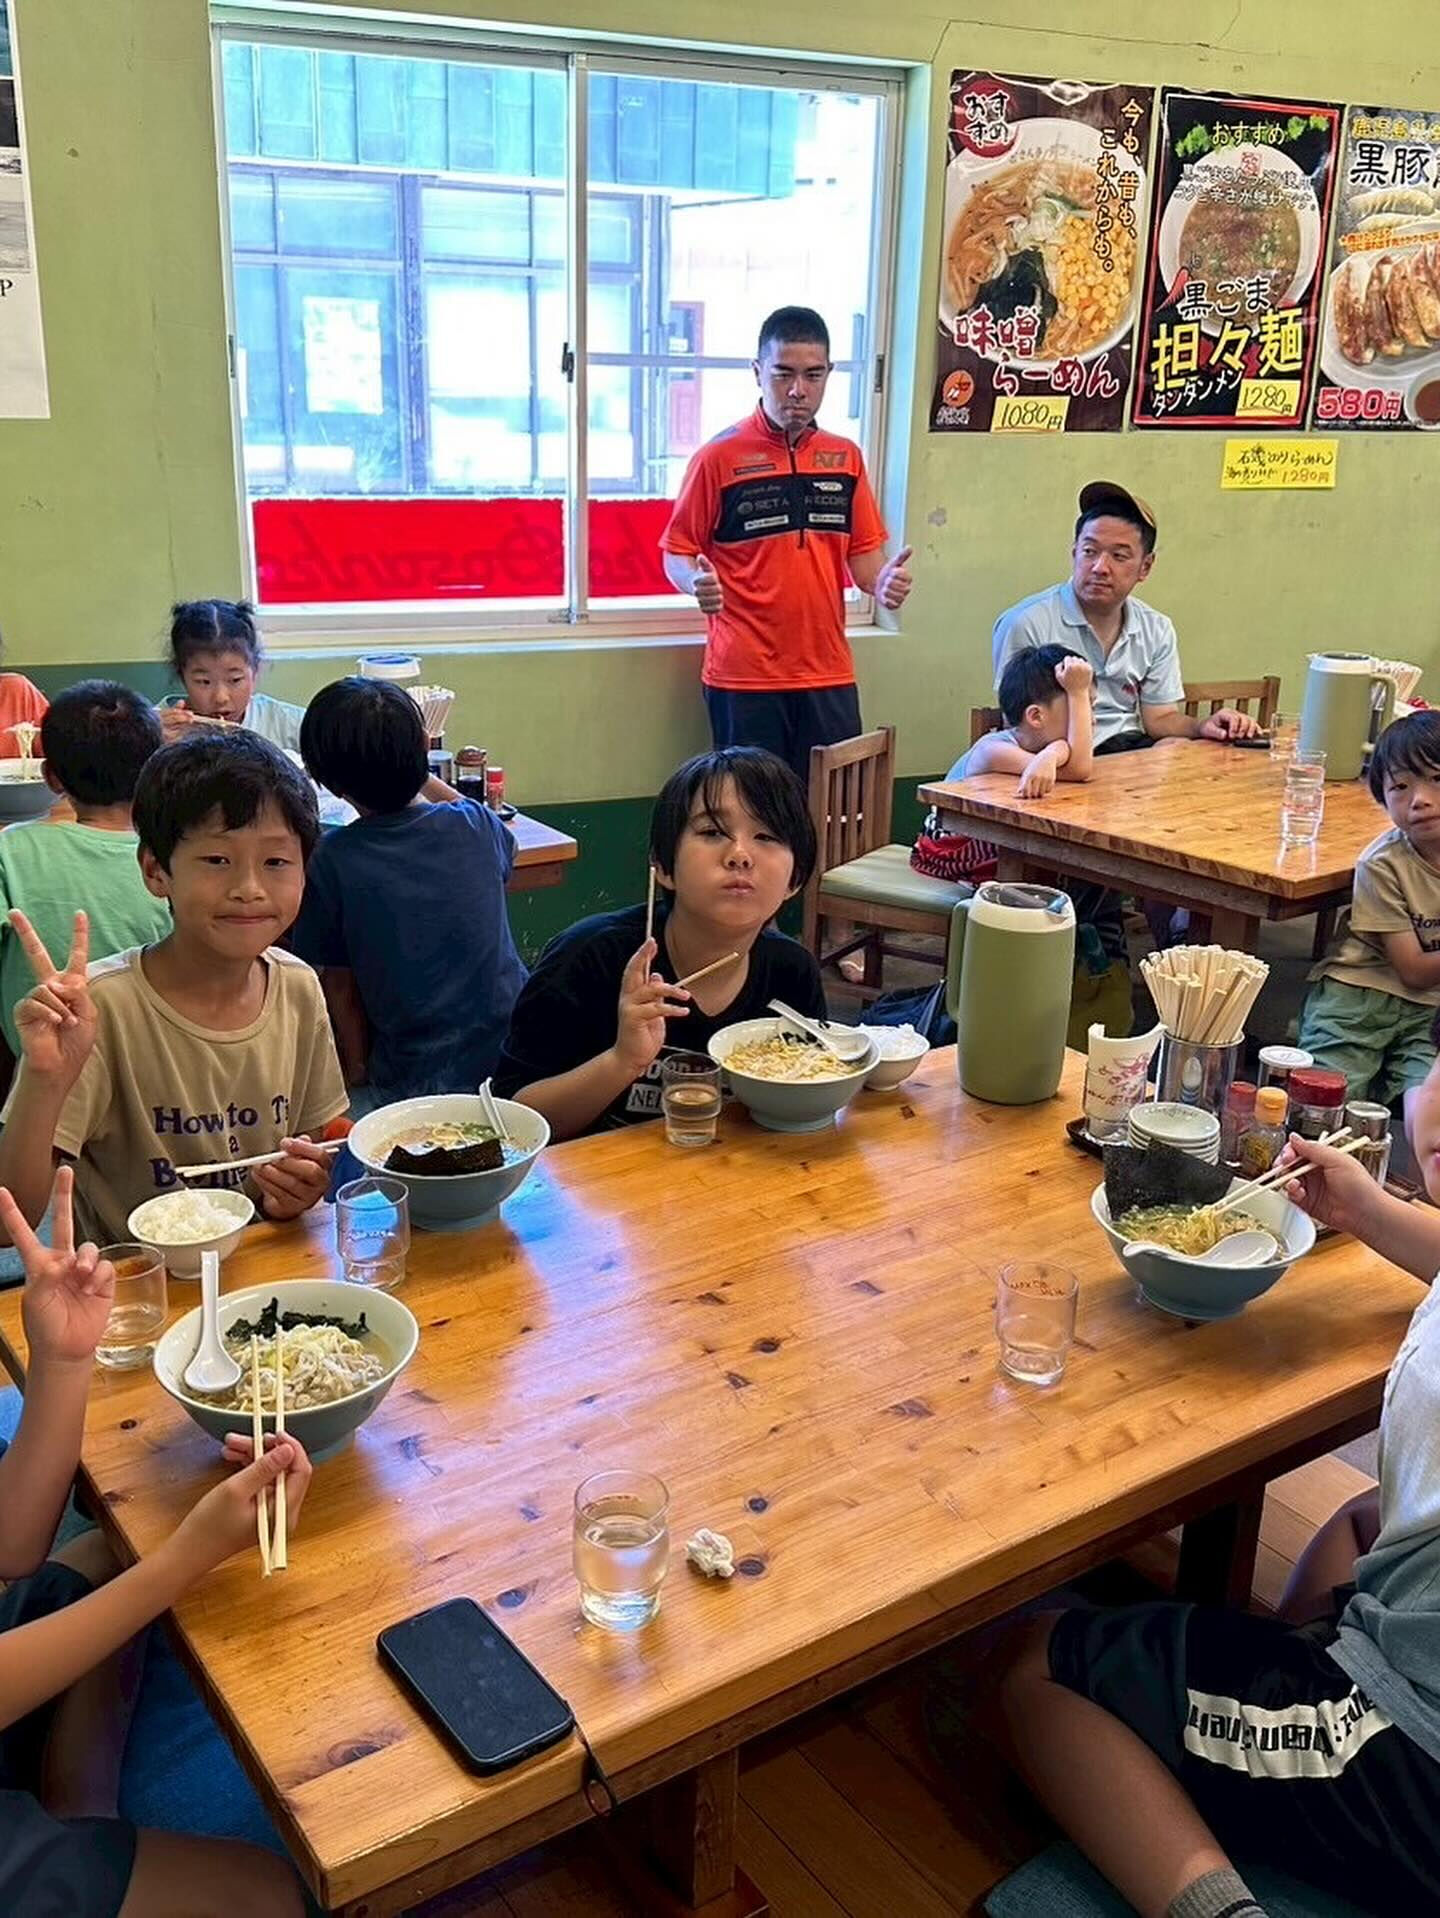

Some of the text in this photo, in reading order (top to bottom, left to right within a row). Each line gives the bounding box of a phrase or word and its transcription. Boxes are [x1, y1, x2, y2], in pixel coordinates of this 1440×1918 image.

[1212, 120, 1286, 147] おすすめ
[1350, 142, 1440, 188] 黒豚
[1093, 127, 1119, 272] これからも。
[1177, 277, 1271, 320] 黒ごま
[955, 304, 1040, 358] 味噌
[1151, 308, 1303, 391] 担々麺
[993, 352, 1119, 397] らーめん
[1153, 370, 1243, 417] タンタンメン
[1001, 401, 1063, 429] 1080円
[1317, 386, 1403, 419] 580円
[153, 1106, 224, 1134] How
[226, 1102, 258, 1128] to
[229, 1136, 240, 1152] a
